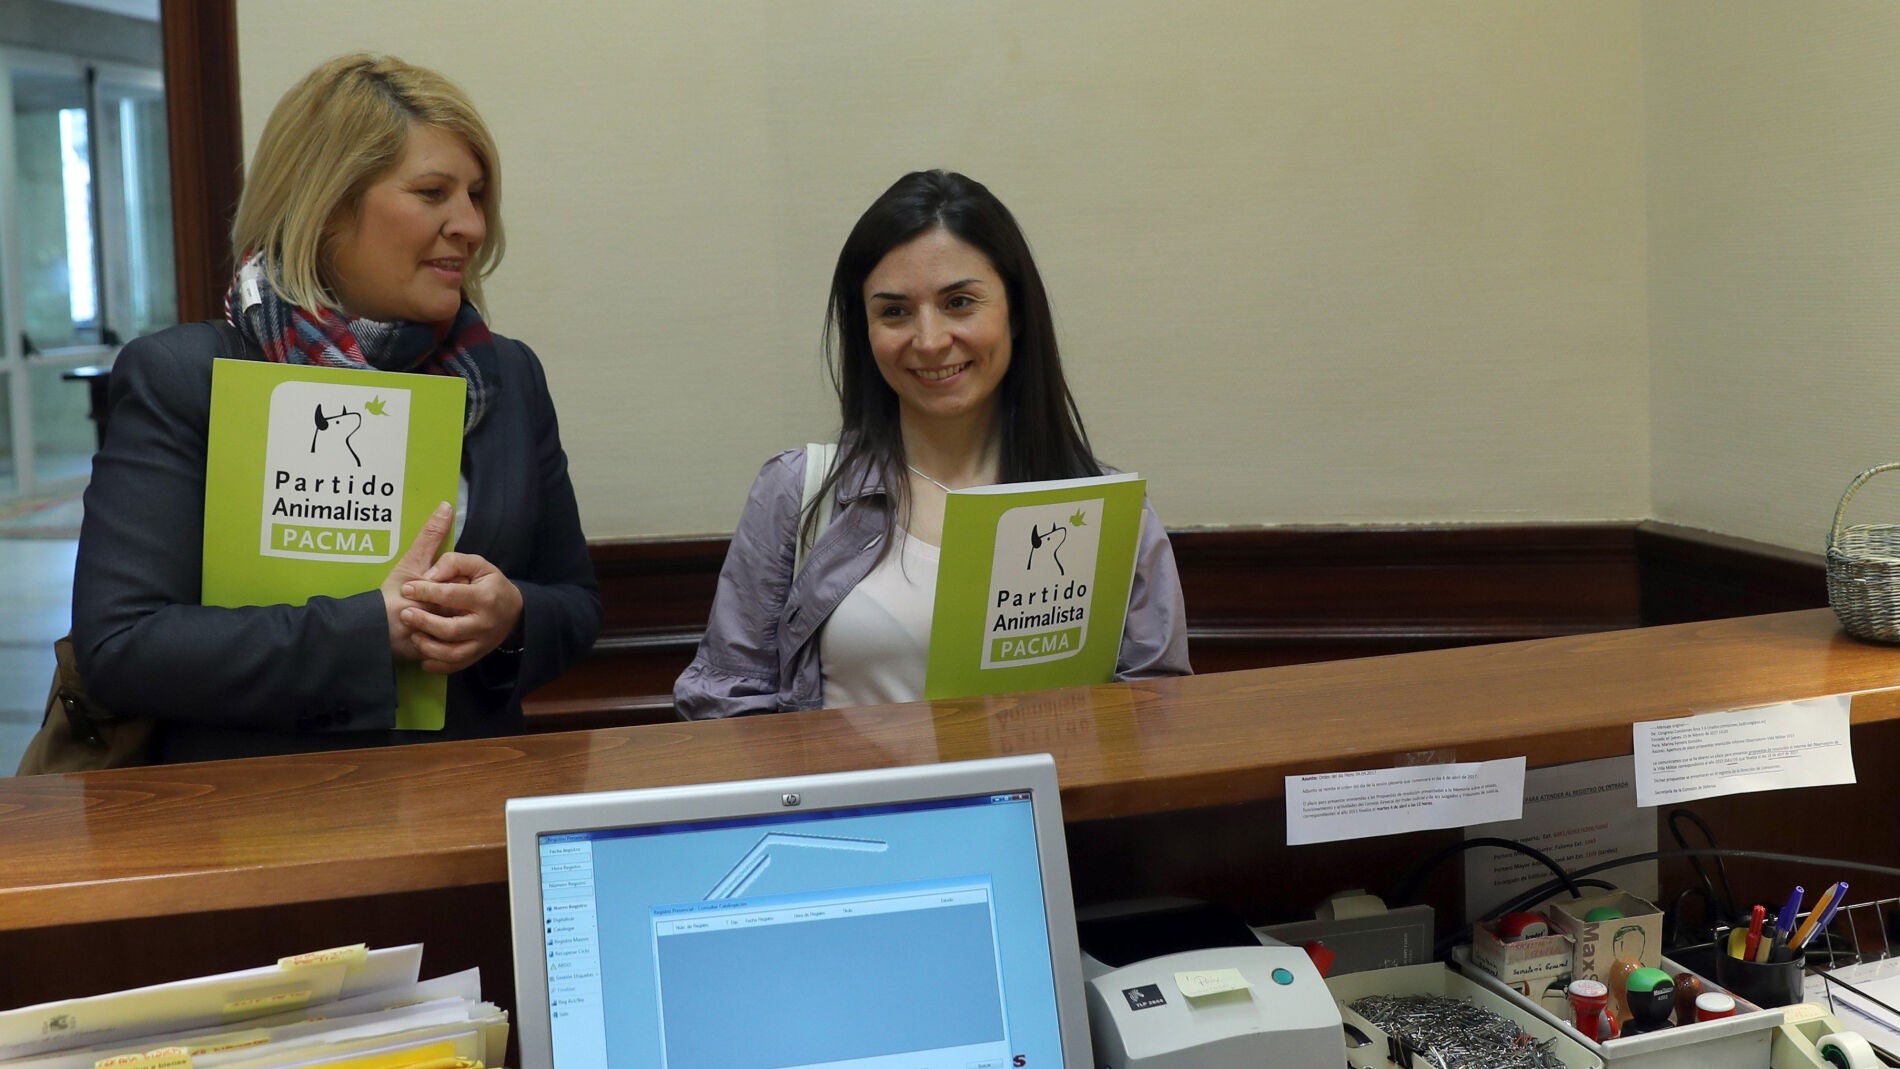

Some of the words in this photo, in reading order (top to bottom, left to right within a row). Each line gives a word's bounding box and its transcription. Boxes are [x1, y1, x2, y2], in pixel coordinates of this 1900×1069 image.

[275, 470, 394, 496] Partido
[271, 497, 393, 523] Animalista
[283, 529, 375, 552] PACMA
[997, 580, 1087, 608] Partido
[992, 606, 1084, 632] Animalista
[1000, 633, 1069, 658] PACMA
